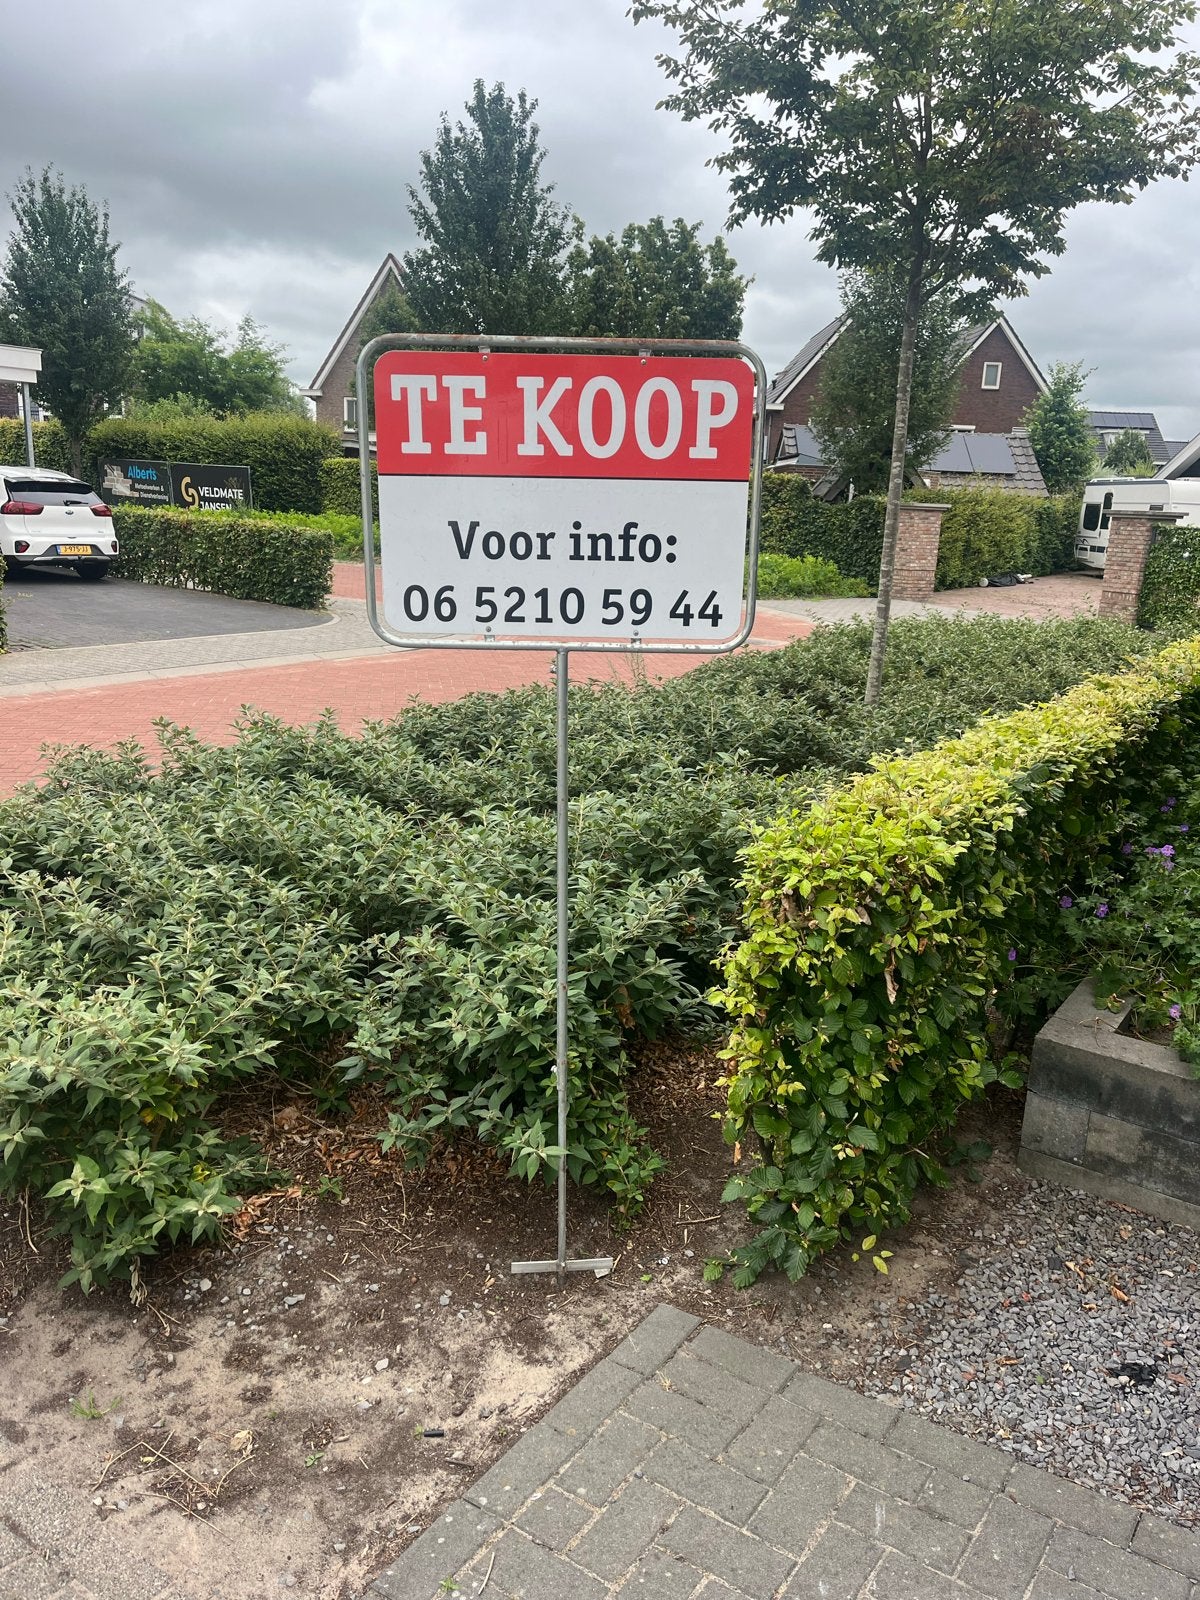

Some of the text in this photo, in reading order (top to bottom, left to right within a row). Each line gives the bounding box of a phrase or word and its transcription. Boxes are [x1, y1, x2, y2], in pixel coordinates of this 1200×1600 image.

[390, 374, 739, 460] TE KOOP
[127, 465, 157, 481] Alberts
[198, 486, 244, 500] VELDMATE
[199, 501, 232, 511] JANSEN
[447, 520, 677, 564] Voor info:
[403, 584, 723, 628] 06 5210 59 44
